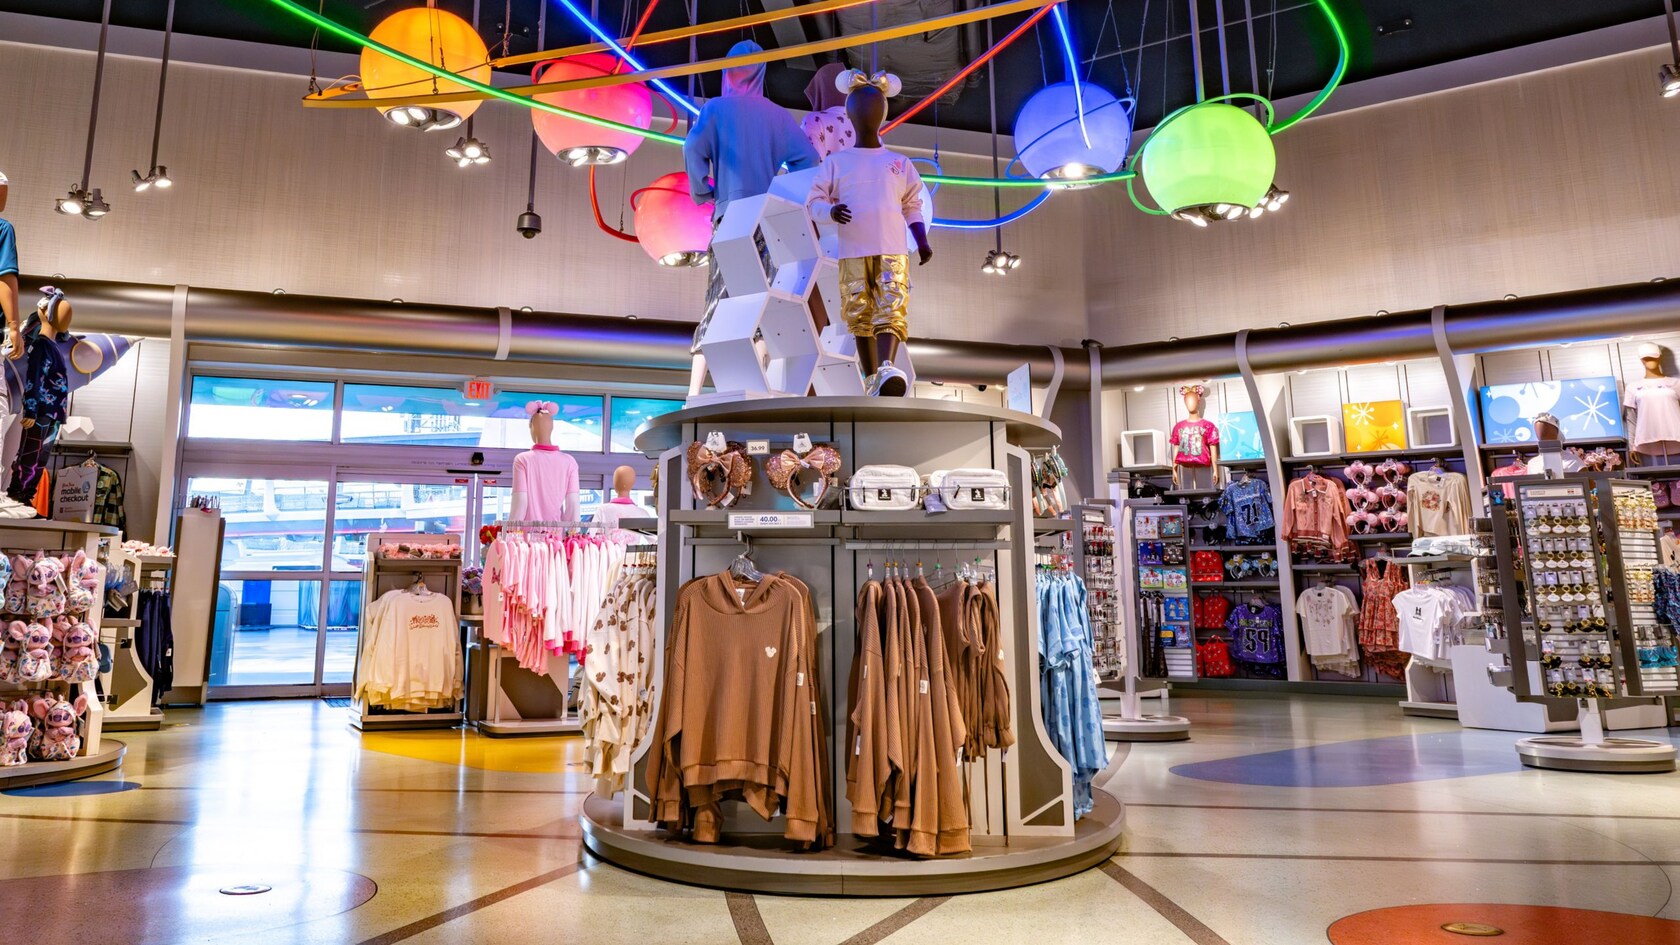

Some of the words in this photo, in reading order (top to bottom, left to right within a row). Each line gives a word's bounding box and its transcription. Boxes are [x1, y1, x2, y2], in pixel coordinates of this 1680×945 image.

[467, 382, 491, 399] EXIT
[61, 487, 81, 495] mobile
[60, 494, 89, 502] checkout
[1243, 628, 1269, 653] 59
